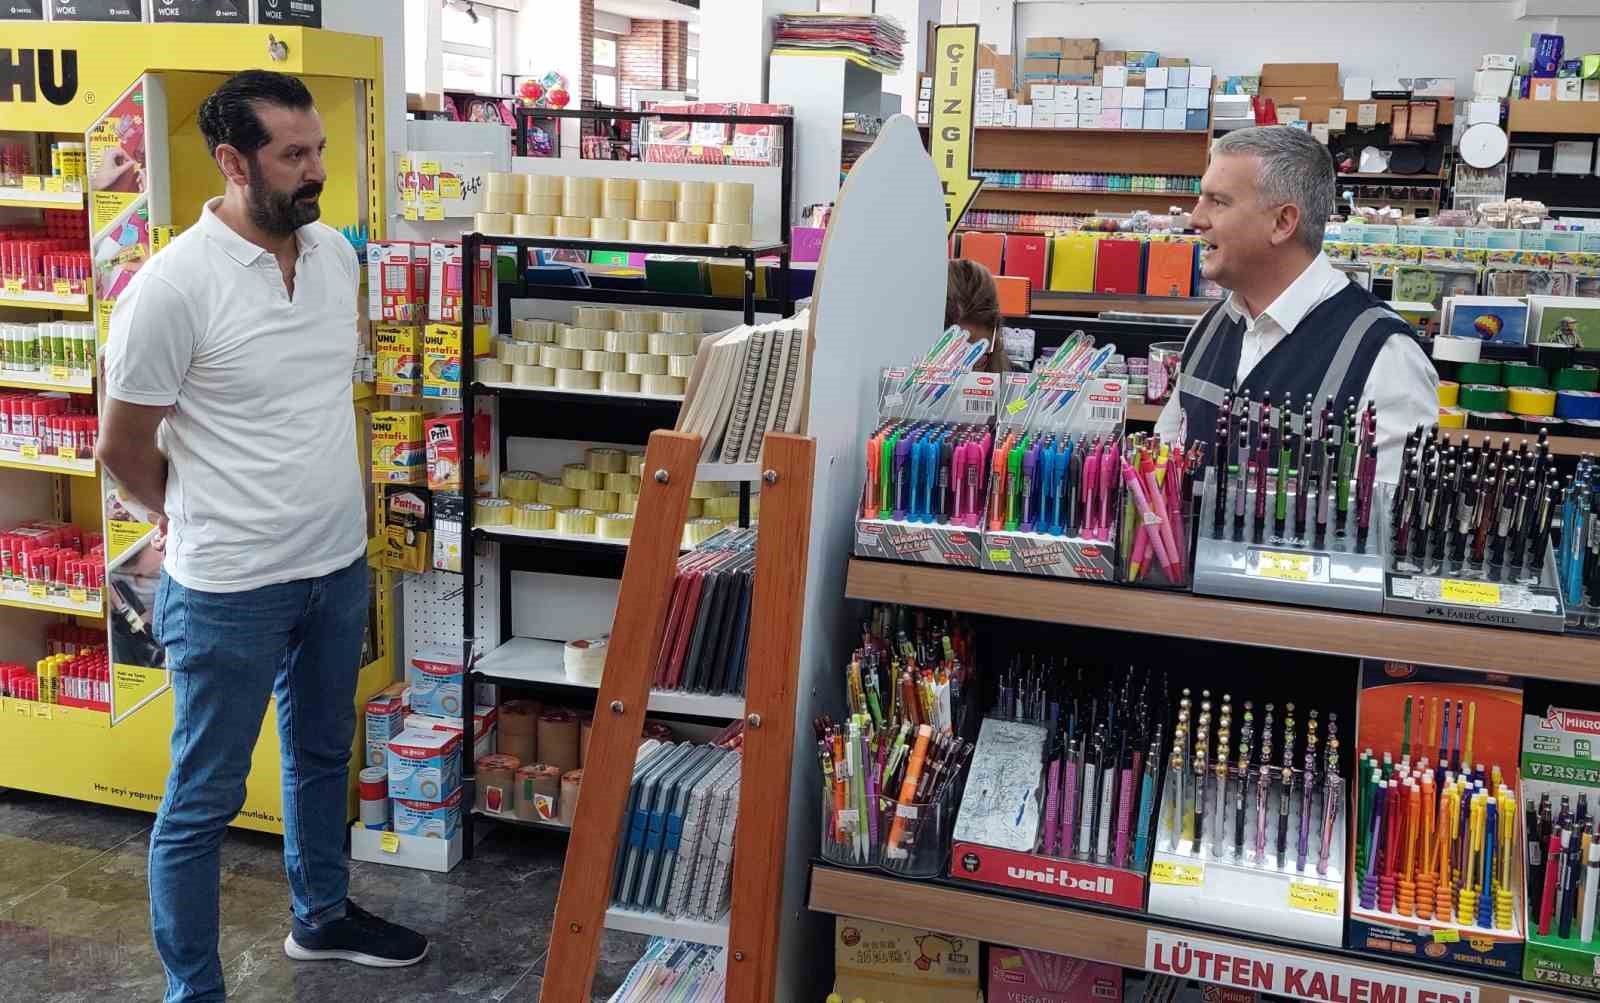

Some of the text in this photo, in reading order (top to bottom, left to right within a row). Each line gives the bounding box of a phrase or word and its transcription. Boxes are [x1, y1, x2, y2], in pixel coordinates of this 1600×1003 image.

[56, 6, 76, 15] WOKE
[158, 8, 180, 16] WOKE
[377, 335, 396, 343] UHU
[425, 336, 443, 345] UHU
[373, 423, 391, 431] UHU
[394, 495, 422, 512] Pattex
[94, 783, 107, 792] Her
[1007, 866, 1114, 896] uni-ball
[1153, 941, 1274, 990] LÜTFEN
